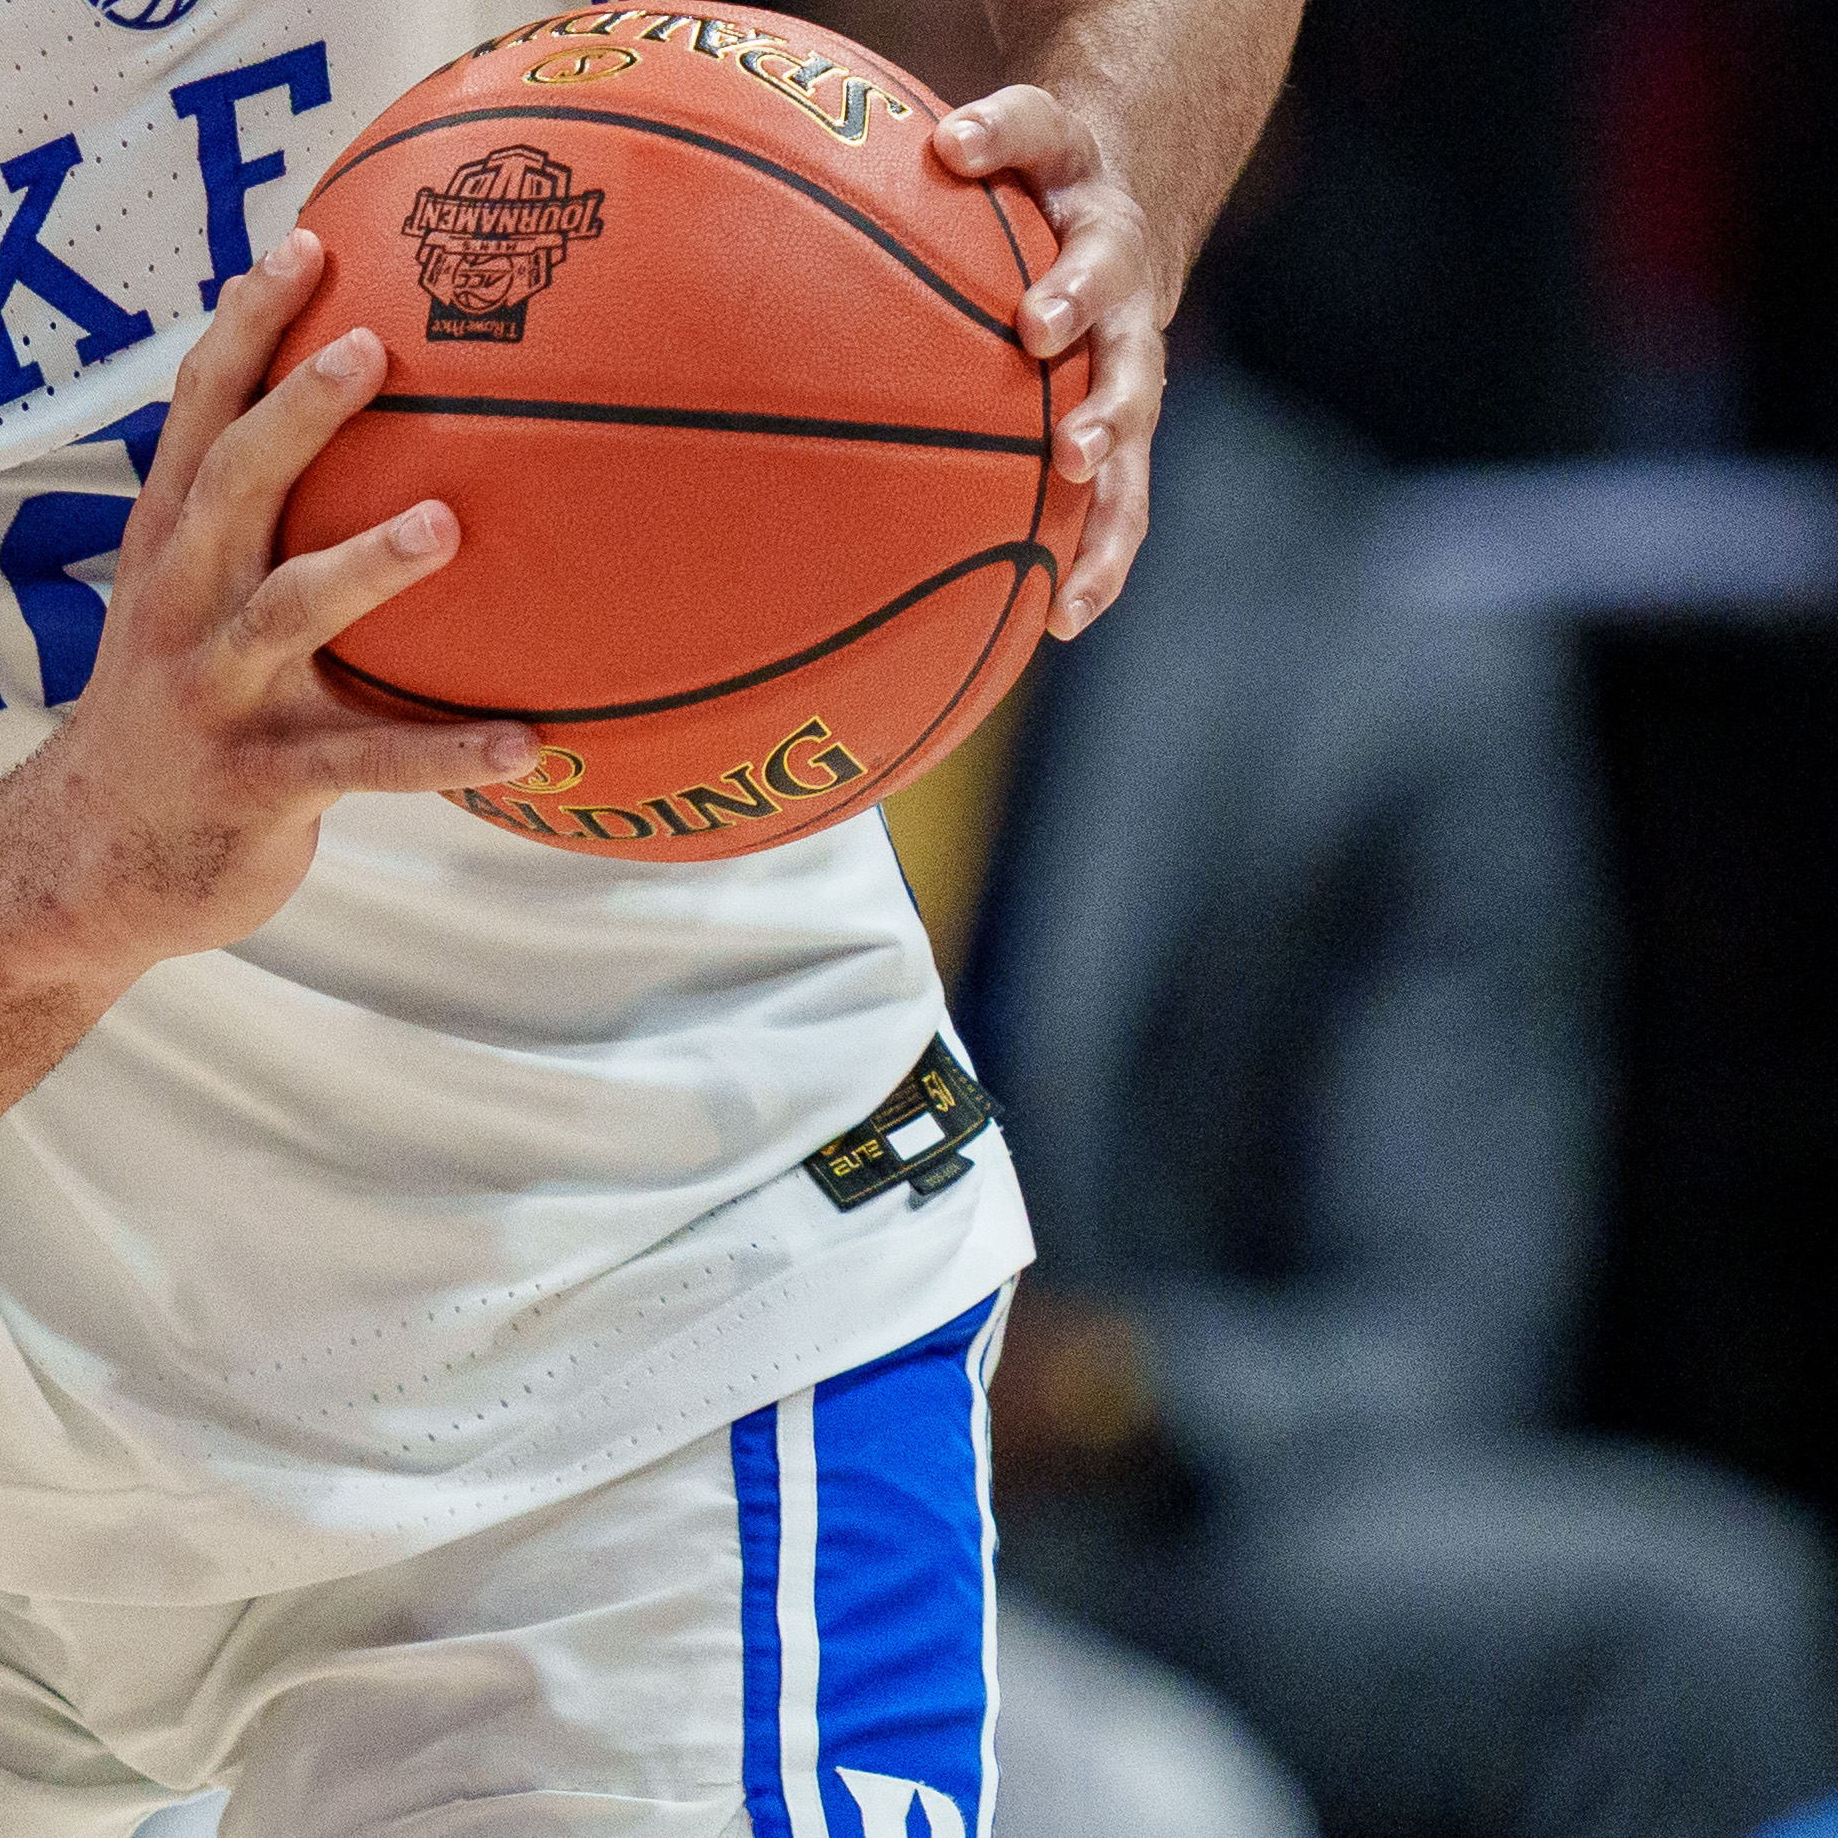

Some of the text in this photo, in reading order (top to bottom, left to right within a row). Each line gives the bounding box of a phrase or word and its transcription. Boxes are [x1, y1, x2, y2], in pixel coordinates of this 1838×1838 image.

[402, 188, 603, 238] TOURNAMENT
[456, 272, 506, 289] ACC
[445, 715, 868, 841] ALDING
[829, 1139, 884, 1178] ELITE
